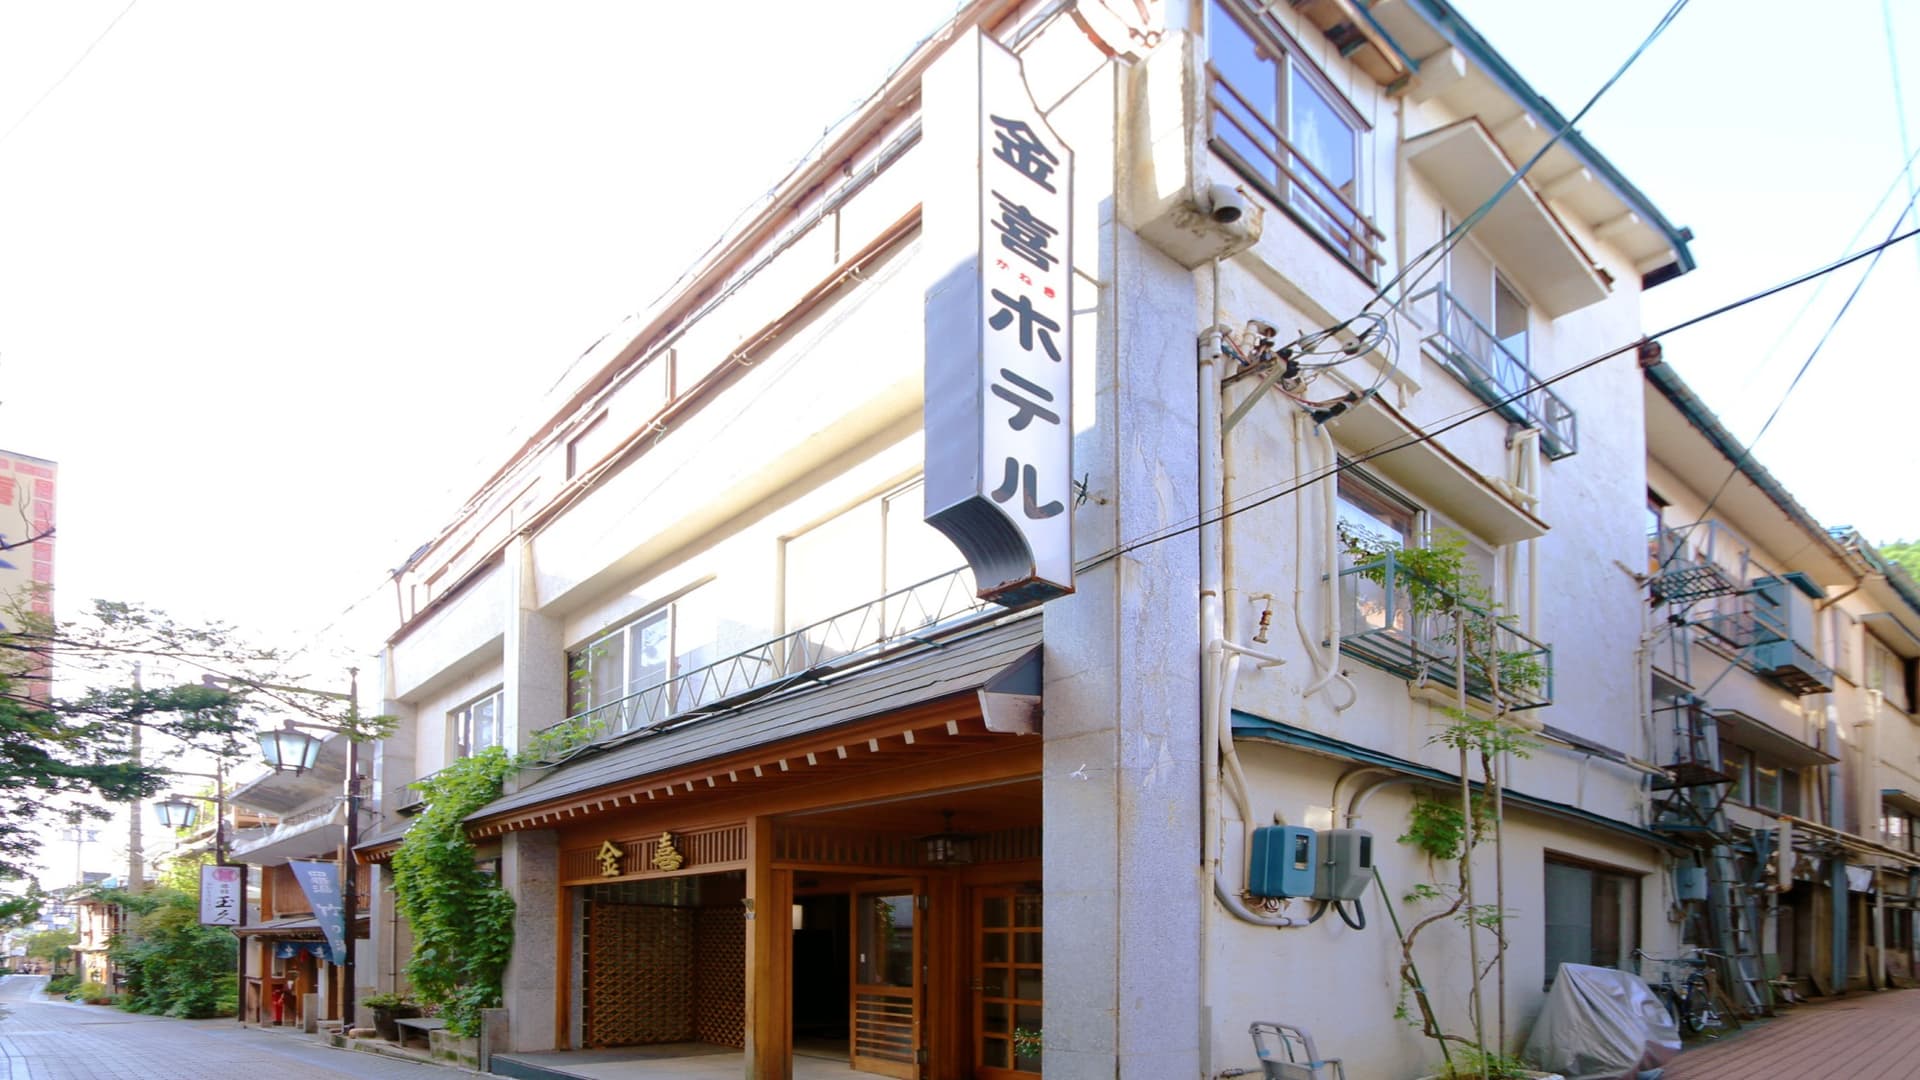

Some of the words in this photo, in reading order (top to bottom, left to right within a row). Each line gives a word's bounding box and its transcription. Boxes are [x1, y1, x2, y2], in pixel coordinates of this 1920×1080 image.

[988, 113, 1065, 520] 金喜ホテル
[595, 832, 683, 876] 金喜
